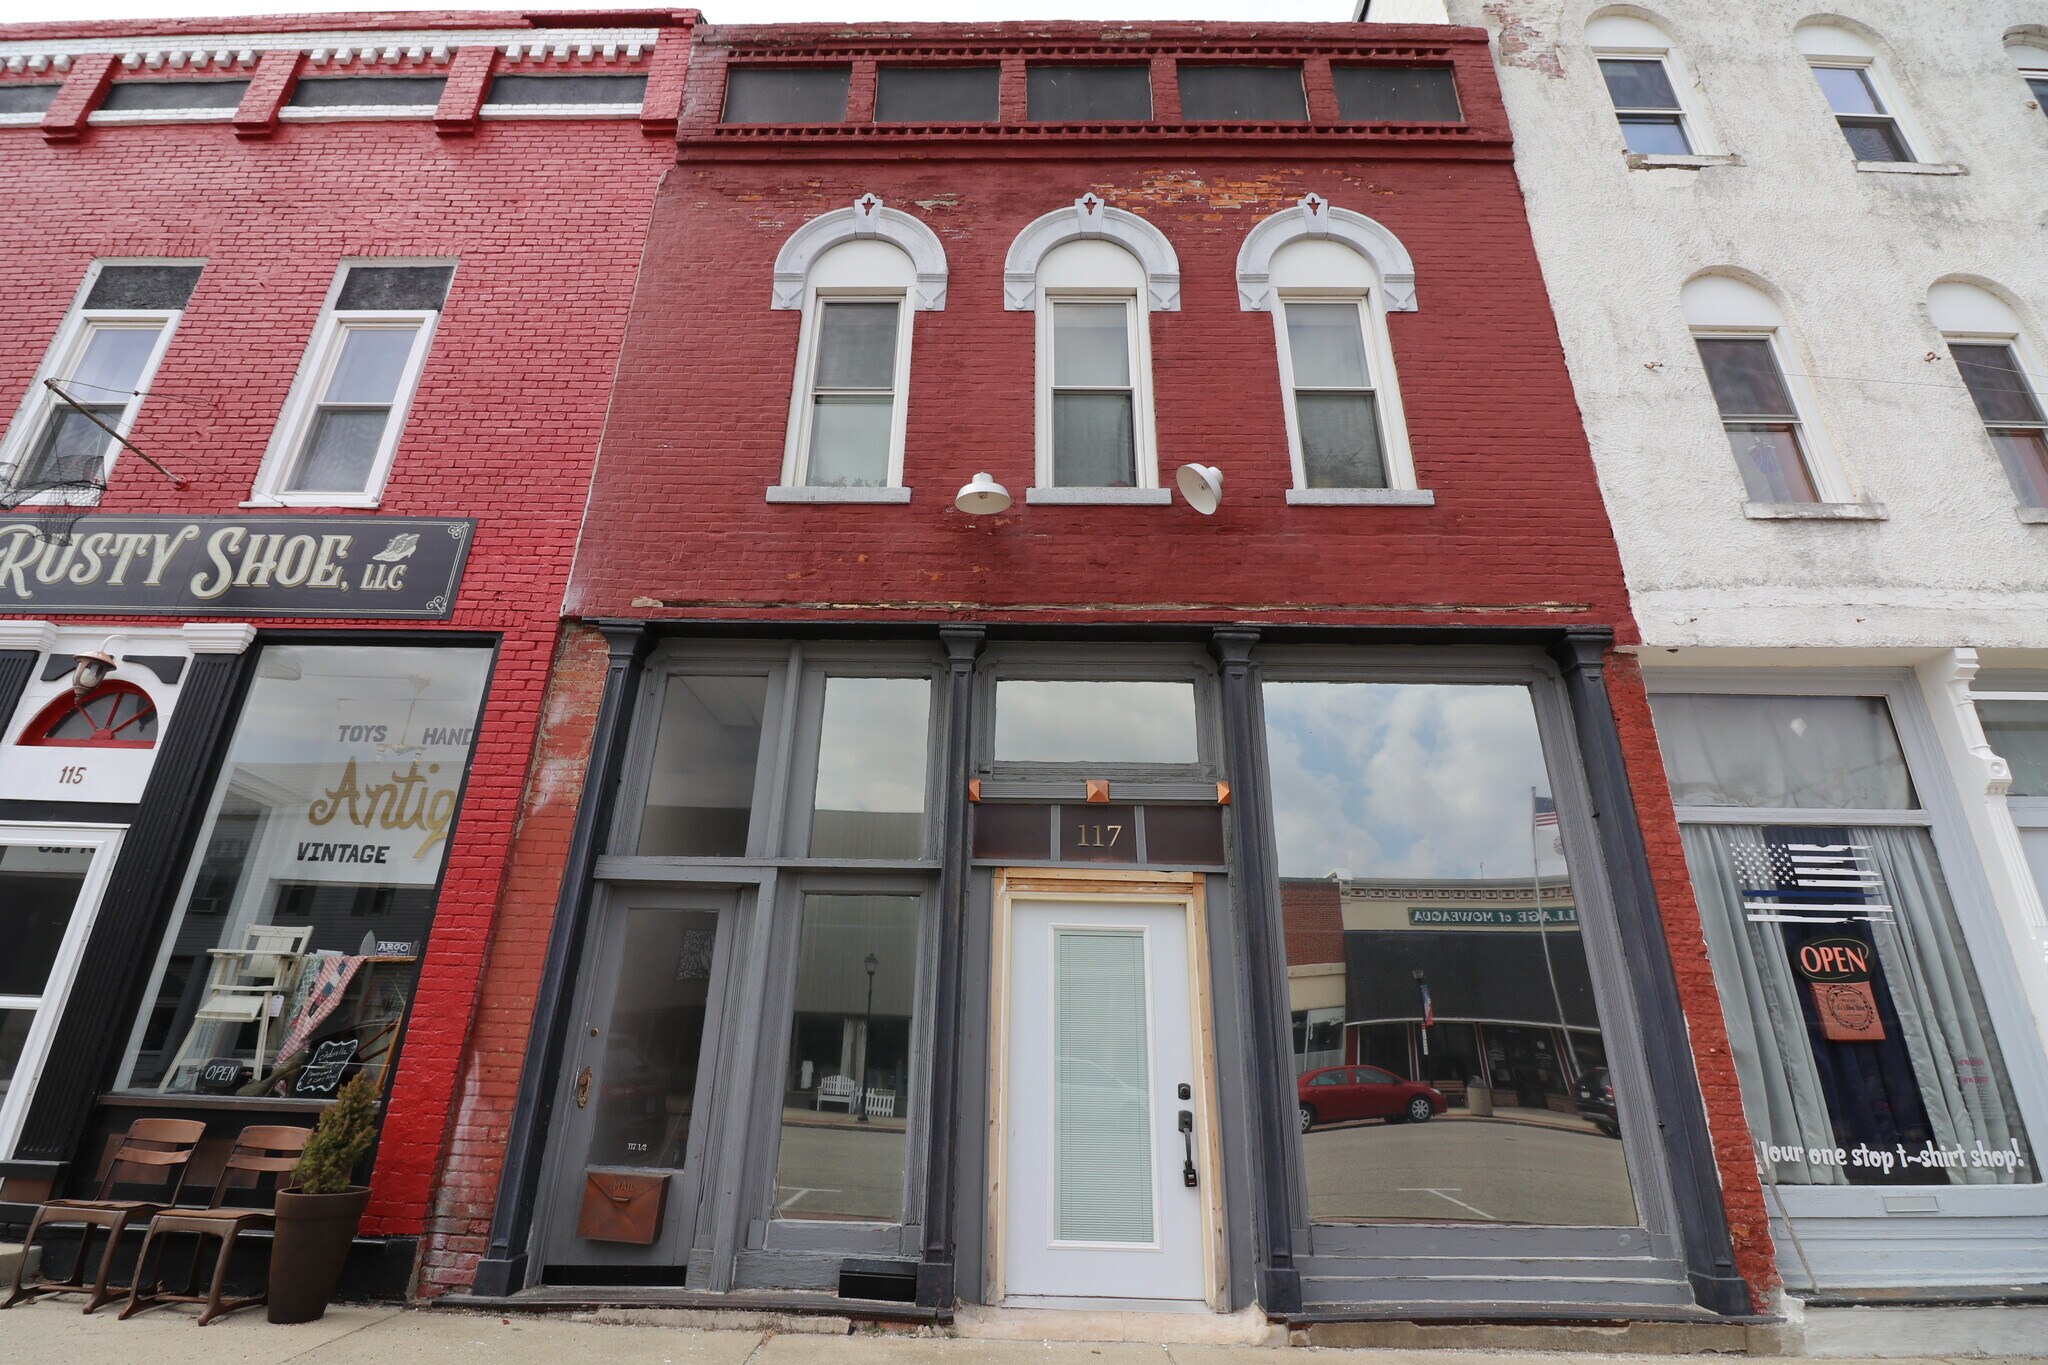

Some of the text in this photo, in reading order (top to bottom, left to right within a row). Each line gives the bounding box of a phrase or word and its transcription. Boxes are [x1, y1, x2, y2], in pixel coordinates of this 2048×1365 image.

[0, 524, 408, 599] RUSTY SHOE, LLC
[338, 725, 387, 743] TOYS
[59, 765, 87, 785] 115
[1077, 824, 1122, 847] 117
[297, 842, 390, 864] VINTAGE
[377, 943, 409, 952] ARGO
[1800, 946, 1868, 973] OPEN
[205, 1065, 239, 1081] OPEN
[1808, 1147, 1848, 1166] one
[1852, 1142, 1895, 1174] stop
[1971, 1137, 2025, 1174] shop!
[613, 1181, 634, 1192] MAIL
